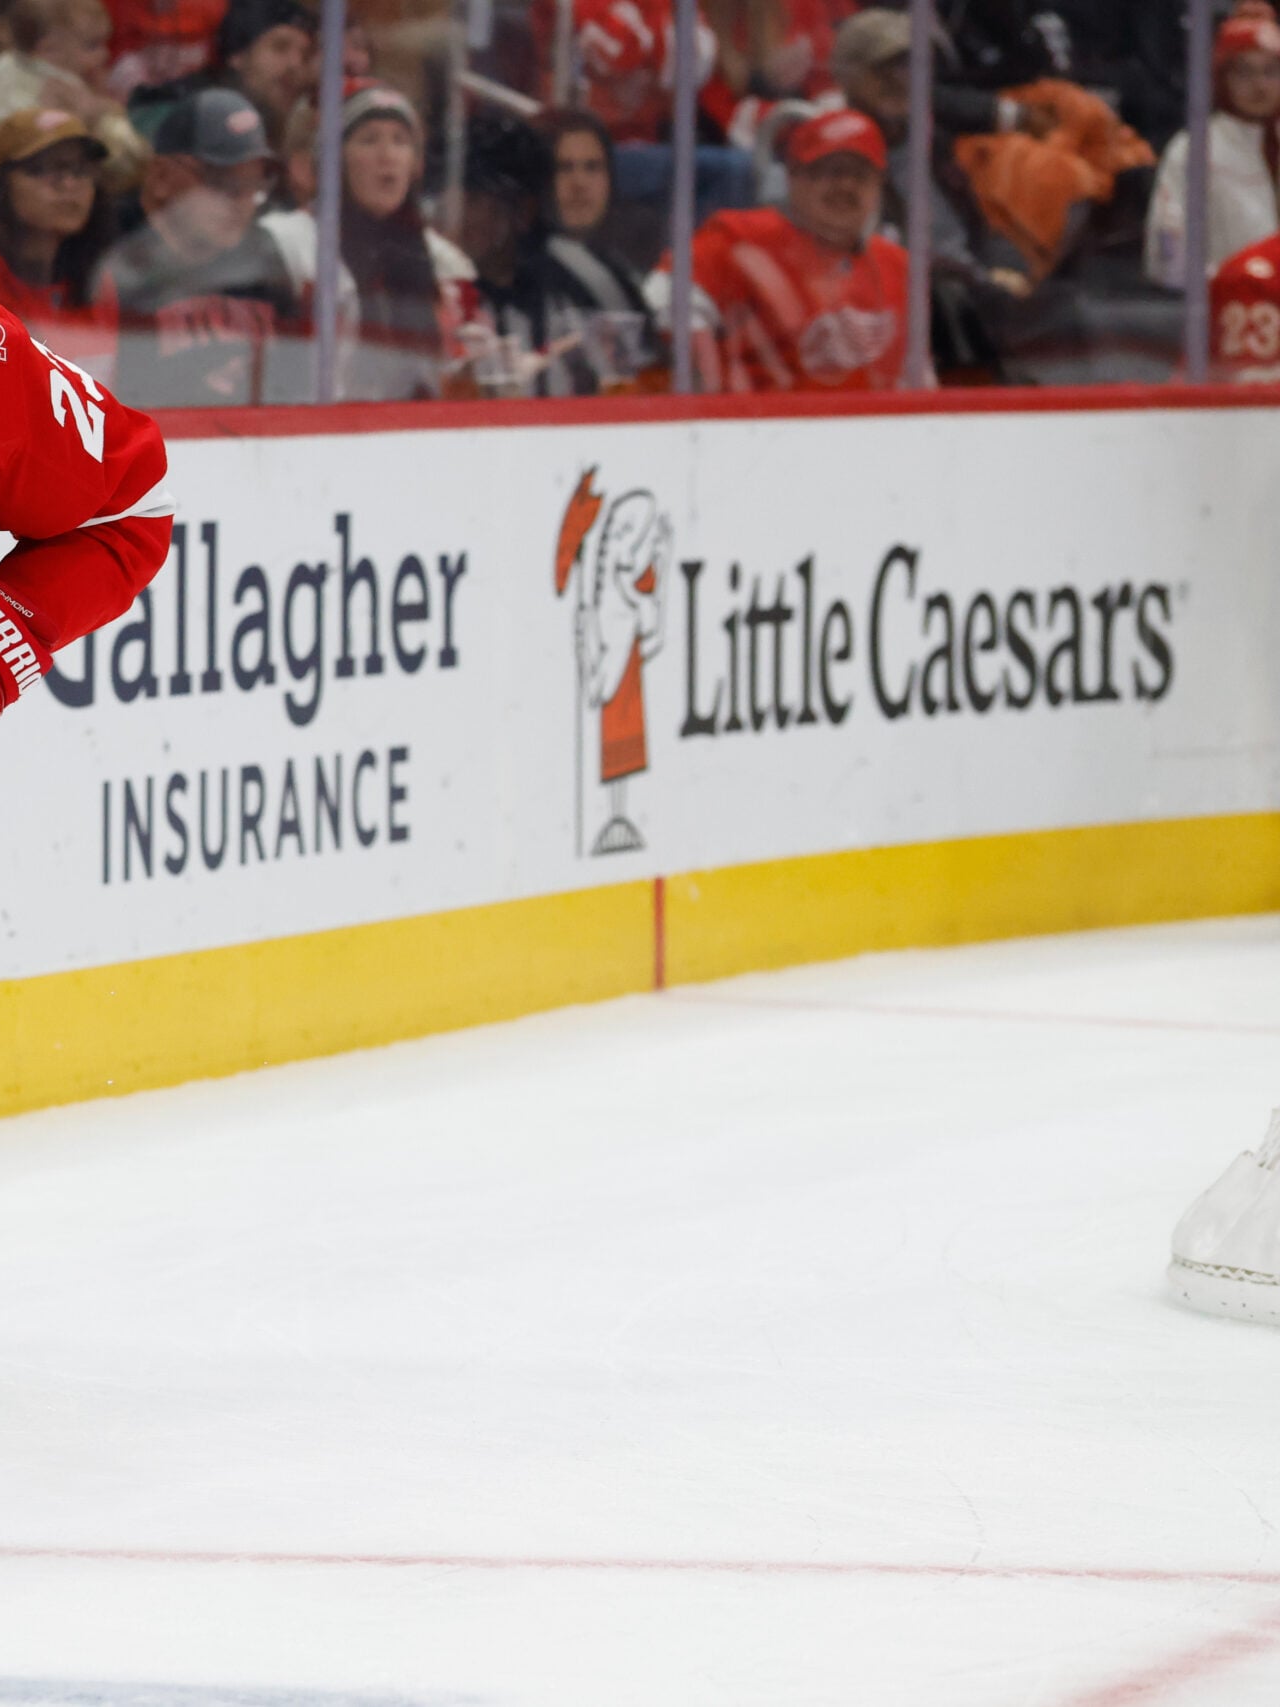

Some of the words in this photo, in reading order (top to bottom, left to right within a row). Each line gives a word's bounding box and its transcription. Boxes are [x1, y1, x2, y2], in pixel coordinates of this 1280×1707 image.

[679, 552, 854, 738] Little
[869, 544, 1174, 720] Caesars
[103, 746, 410, 884] INSURANCE
